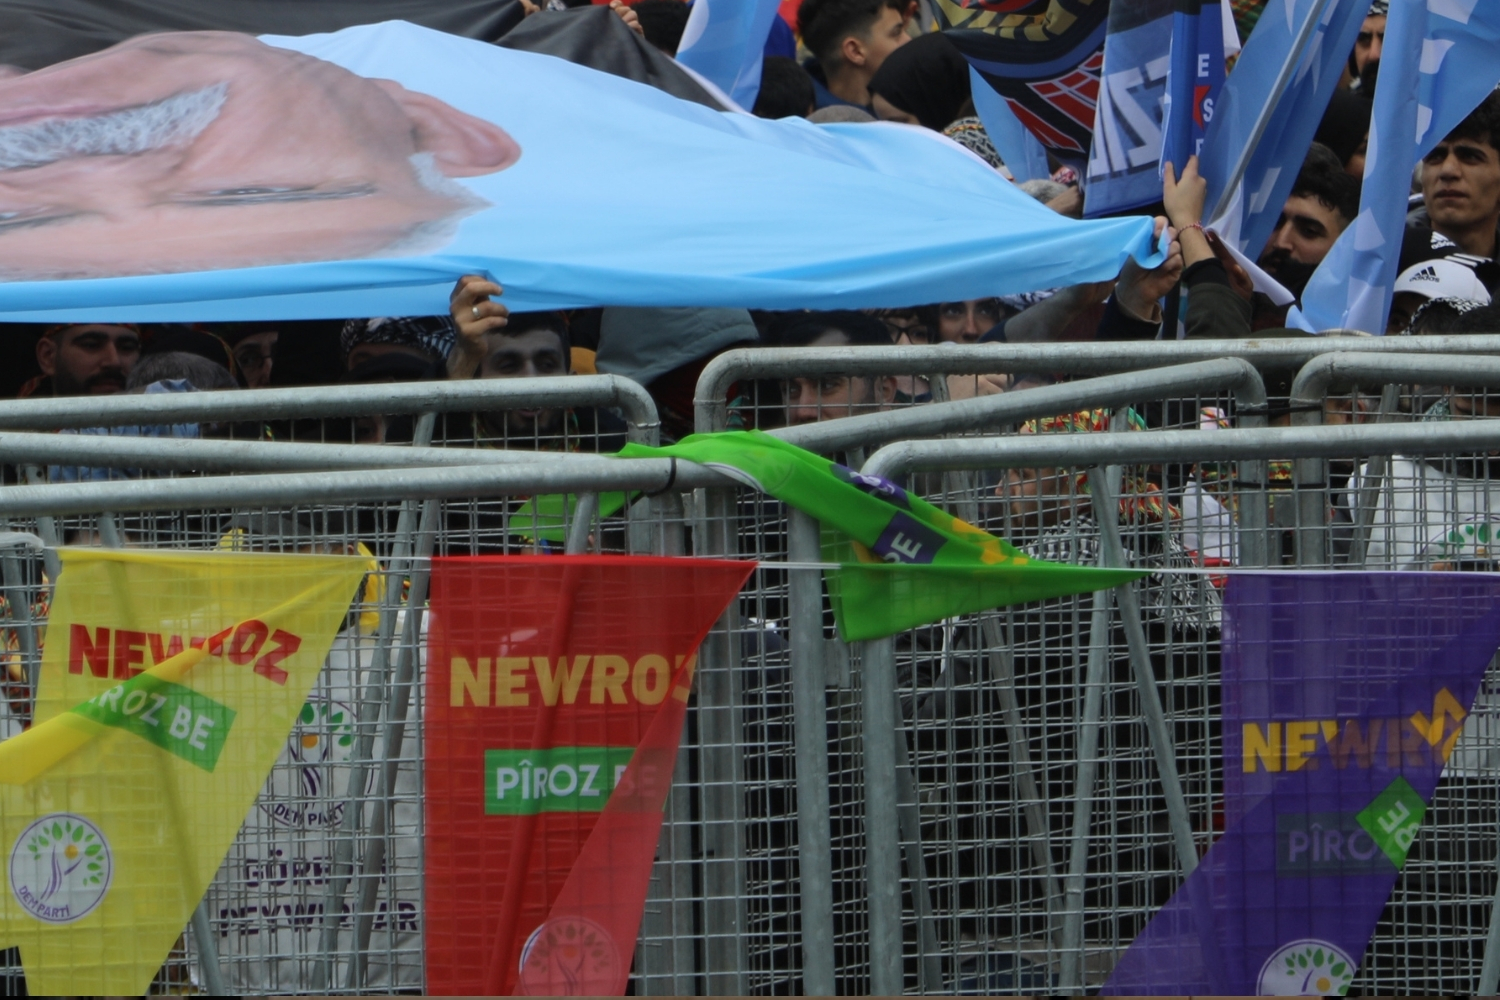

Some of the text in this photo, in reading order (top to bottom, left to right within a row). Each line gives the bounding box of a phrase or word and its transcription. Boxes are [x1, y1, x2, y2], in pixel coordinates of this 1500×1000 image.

[68, 619, 302, 686] NEWOZ
[90, 685, 215, 751] ROZ BE
[496, 759, 600, 800] PÎROZ
[308, 801, 348, 825] PART
[1288, 823, 1378, 864] PÎRO
[19, 885, 39, 909] DEM
